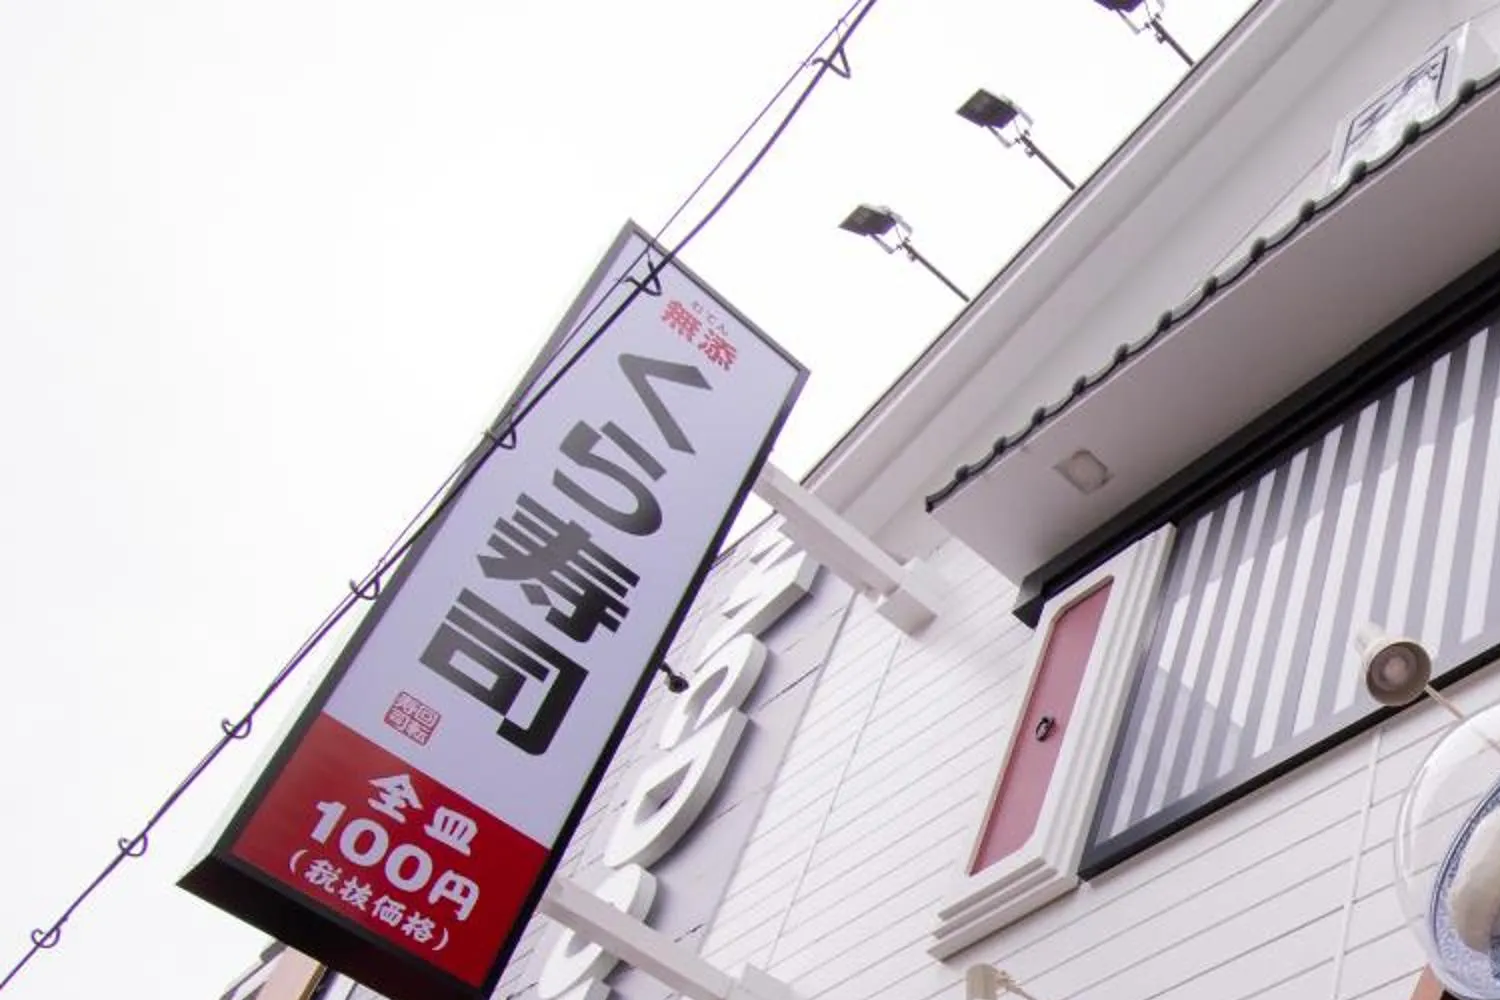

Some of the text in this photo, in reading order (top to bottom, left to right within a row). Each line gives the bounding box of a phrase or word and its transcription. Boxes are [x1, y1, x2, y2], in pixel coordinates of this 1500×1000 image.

[418, 353, 713, 756] くら寿司
[310, 801, 480, 921] 100円
[368, 774, 478, 856] 全皿
